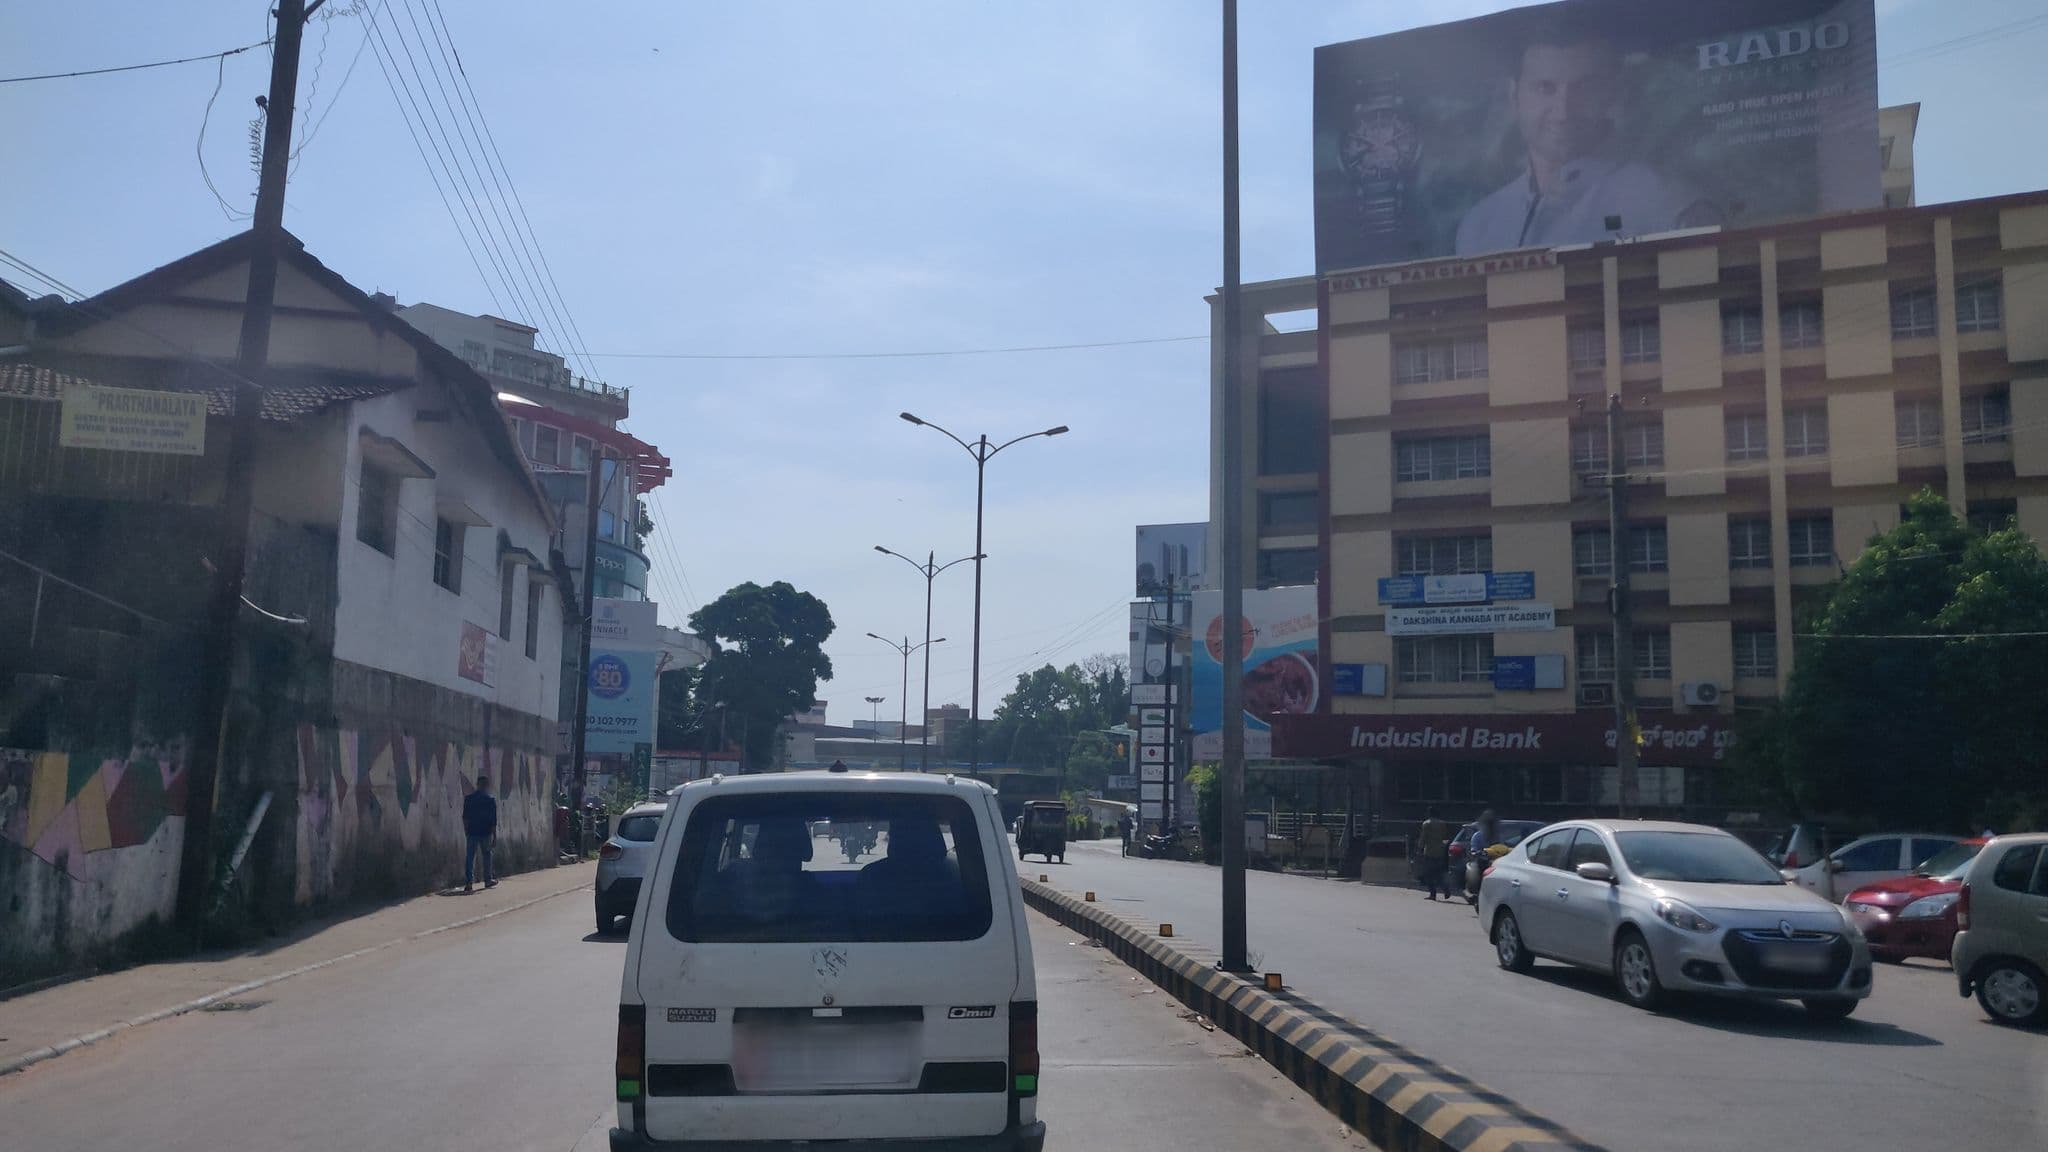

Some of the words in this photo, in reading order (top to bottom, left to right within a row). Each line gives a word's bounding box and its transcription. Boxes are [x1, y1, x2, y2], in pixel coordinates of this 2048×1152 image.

[1696, 22, 1849, 71] RADO
[1703, 102, 1735, 116] RADO
[1740, 96, 1768, 110] TRUE
[1771, 91, 1802, 104] OPEN
[1332, 274, 1389, 289] HOTEL
[1403, 615, 1447, 625] DAKSHINA
[1449, 613, 1491, 624] KANNADA
[1494, 613, 1506, 622] IIT
[1508, 611, 1551, 622] ACADEMY
[592, 625, 629, 635] INNACLE
[598, 716, 615, 725] 102
[615, 716, 639, 726] 9977
[1350, 726, 1467, 748] IndusInd
[1472, 727, 1542, 748] Bank
[950, 1007, 993, 1018] Omni
